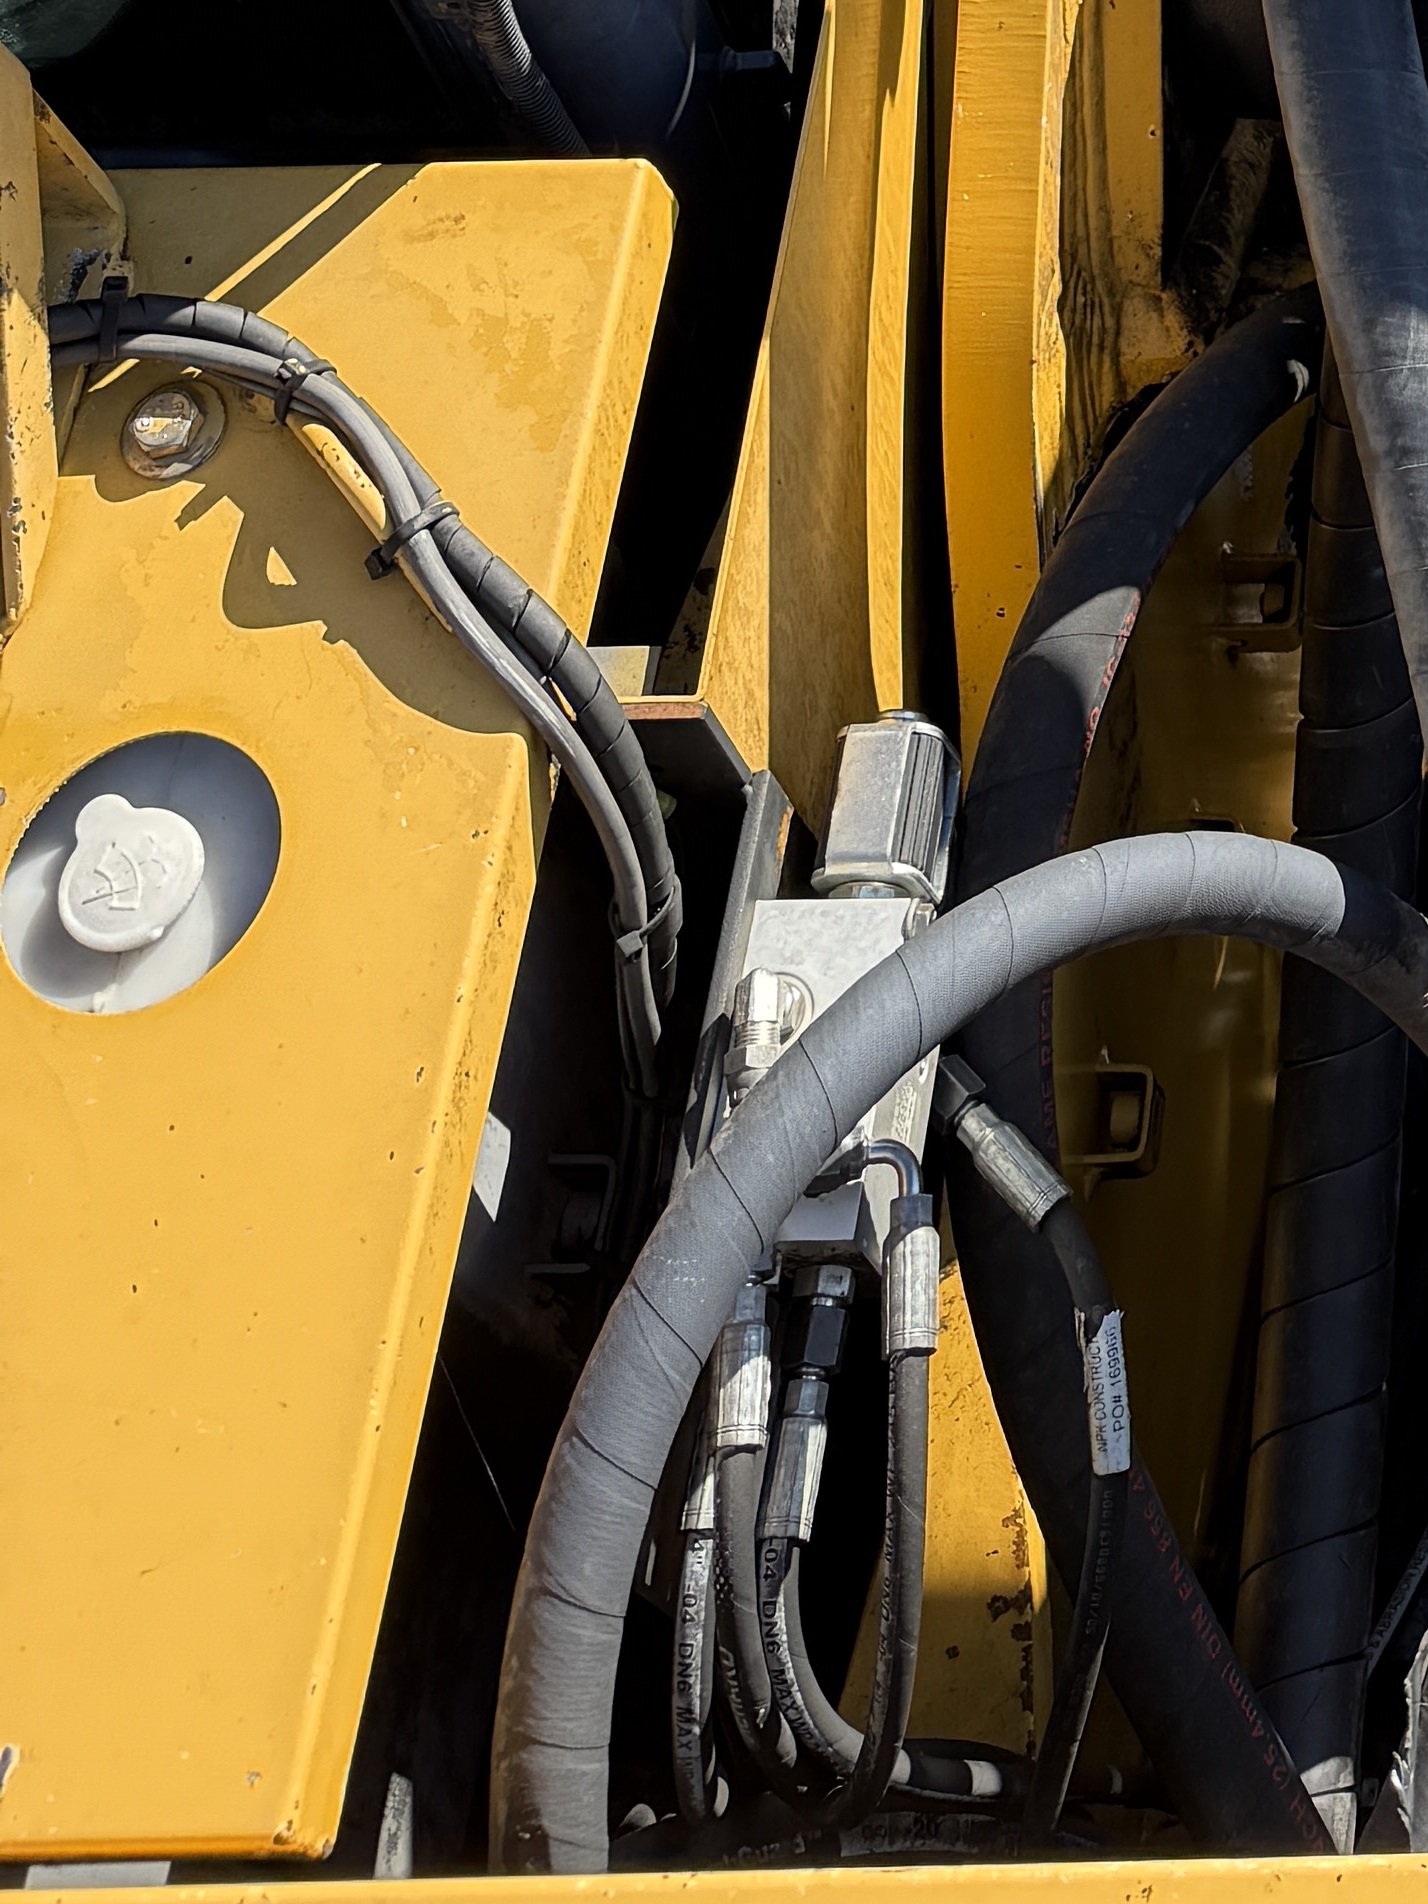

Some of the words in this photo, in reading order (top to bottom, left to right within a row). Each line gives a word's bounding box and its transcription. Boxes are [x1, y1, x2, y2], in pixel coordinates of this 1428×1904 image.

[762, 1600, 781, 1654] DN6
[676, 1641, 696, 1691] DN6
[771, 1667, 800, 1716] MAX
[674, 1706, 699, 1752] MAX
